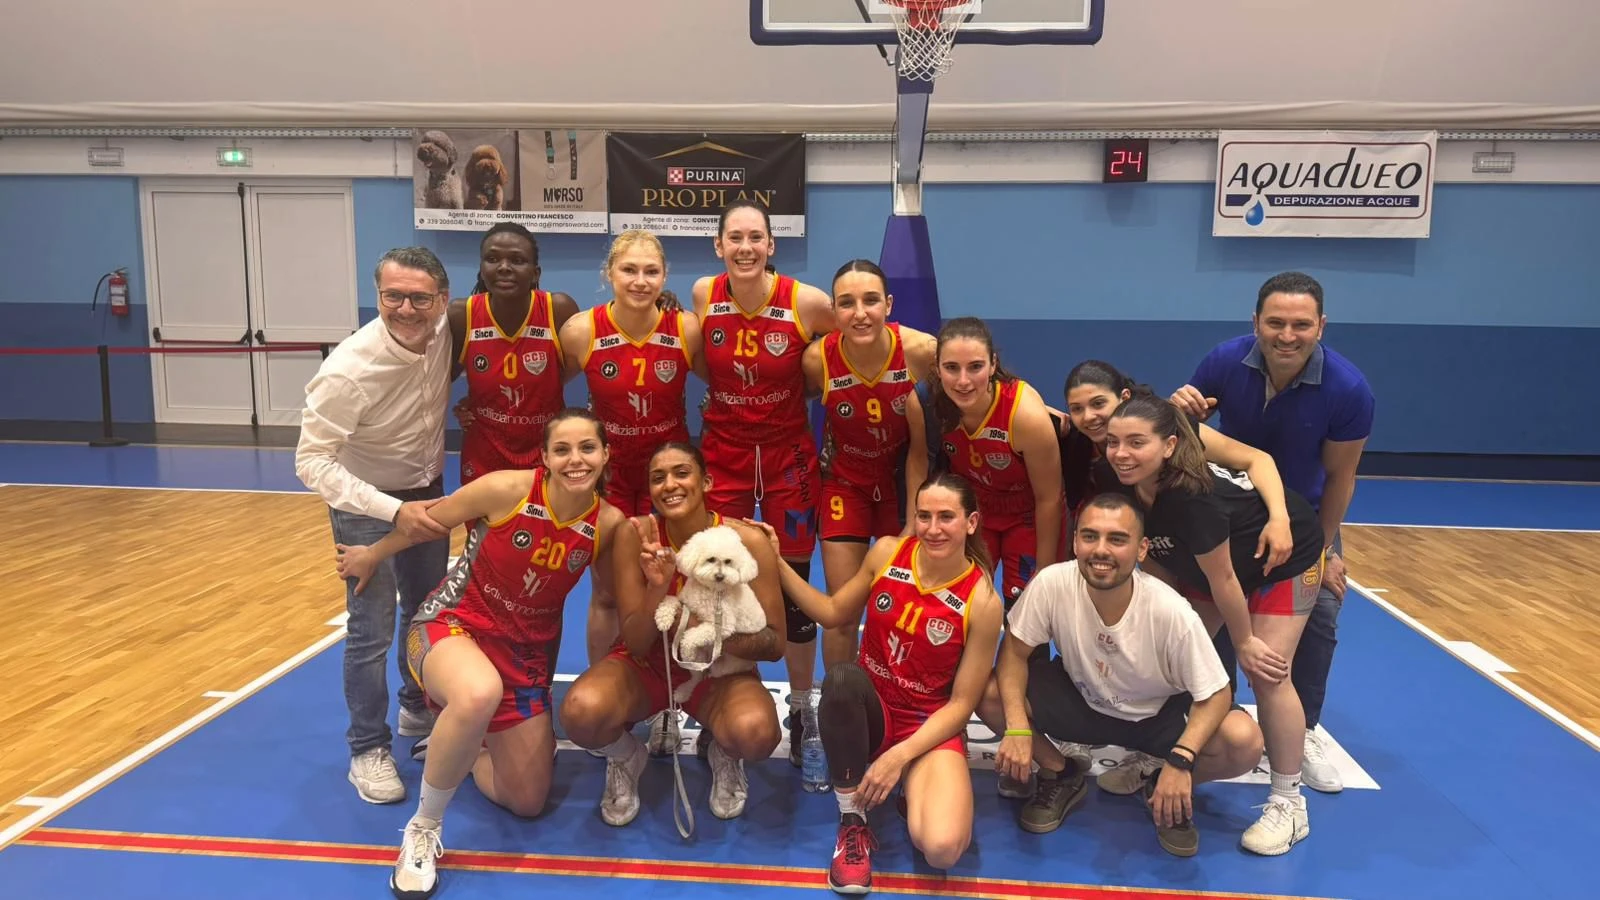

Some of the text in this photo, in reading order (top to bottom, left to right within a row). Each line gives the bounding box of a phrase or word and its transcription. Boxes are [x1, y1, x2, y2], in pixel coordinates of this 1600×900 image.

[1110, 151, 1142, 174] 24
[686, 171, 741, 181] PURINA
[641, 188, 696, 208] PRO
[1274, 197, 1411, 206] DEPURAZIONE ACQUE
[448, 211, 469, 219] Agente
[474, 327, 545, 339] Since 1996
[600, 337, 620, 348] Since
[733, 328, 759, 357] 15
[766, 334, 787, 343] CCB
[503, 351, 518, 379] 0
[524, 352, 546, 363] CCB
[632, 357, 647, 386] 7
[833, 377, 853, 388] Since
[866, 398, 882, 423] 9
[989, 429, 1006, 441] 1996
[969, 443, 984, 468] 6
[829, 495, 845, 521] 9
[530, 536, 566, 571] 20
[888, 567, 963, 610] Since 1996
[895, 600, 924, 636] 11
[929, 618, 952, 634] CCB
